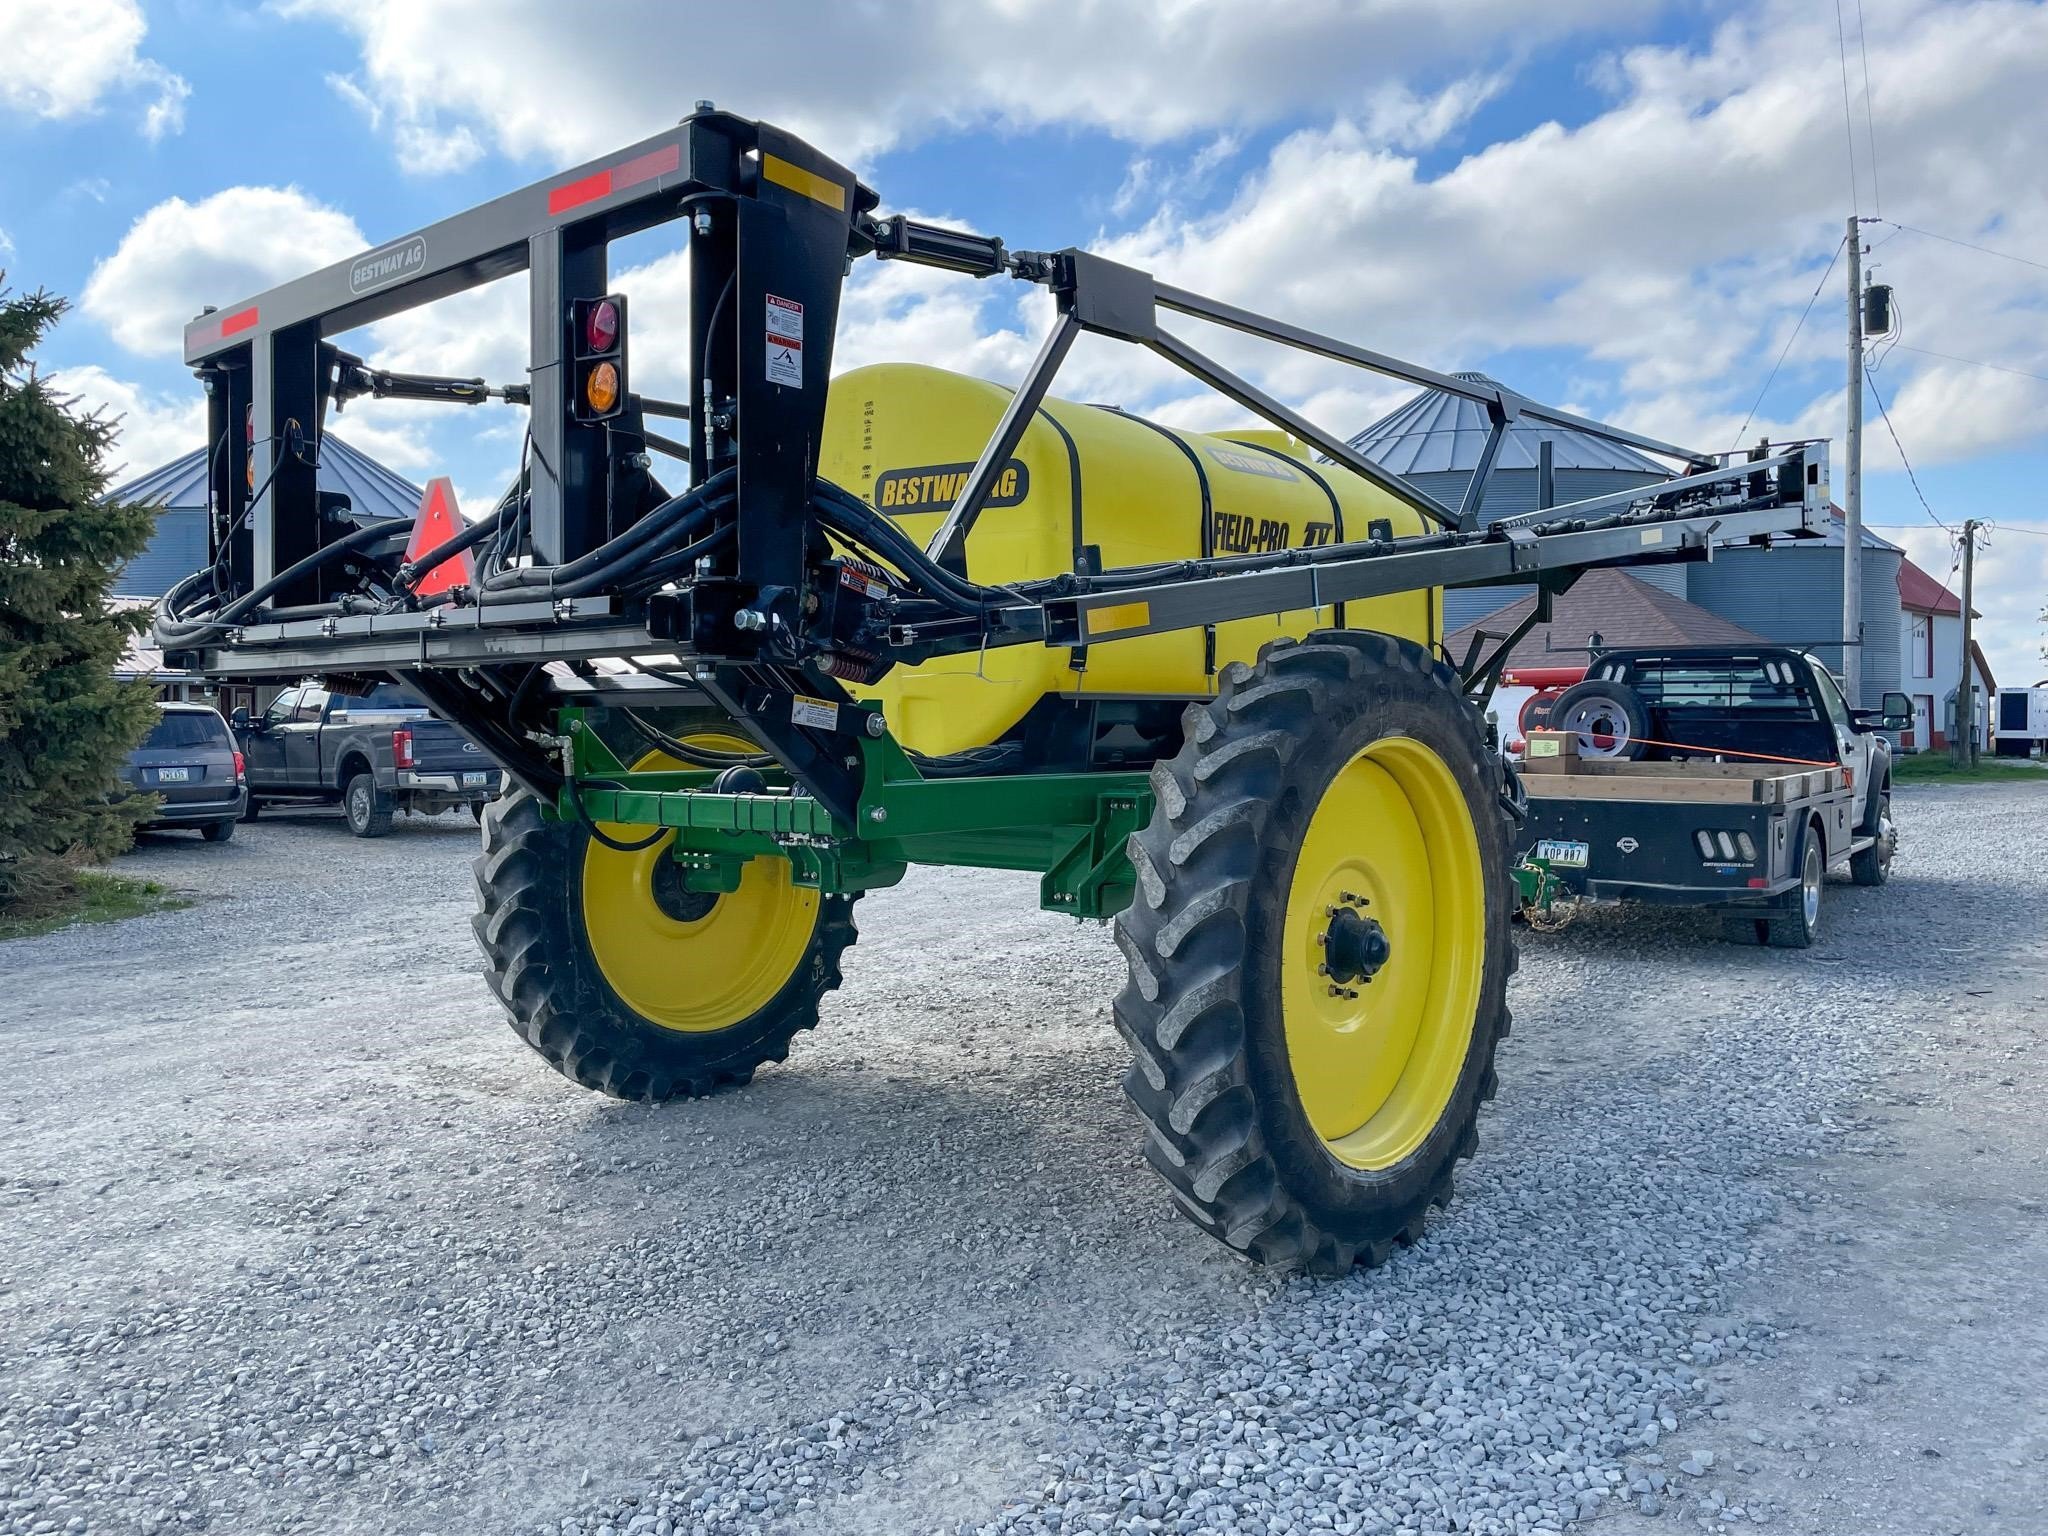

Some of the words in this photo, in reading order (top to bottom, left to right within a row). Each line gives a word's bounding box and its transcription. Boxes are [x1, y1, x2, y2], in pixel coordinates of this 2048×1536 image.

[353, 251, 405, 286] BESTWAY
[405, 245, 421, 266] AG
[776, 299, 799, 311] DANGER
[881, 472, 971, 507] BESTWA
[1213, 511, 1290, 553] FIELD-PRO
[1544, 848, 1561, 860] KOP
